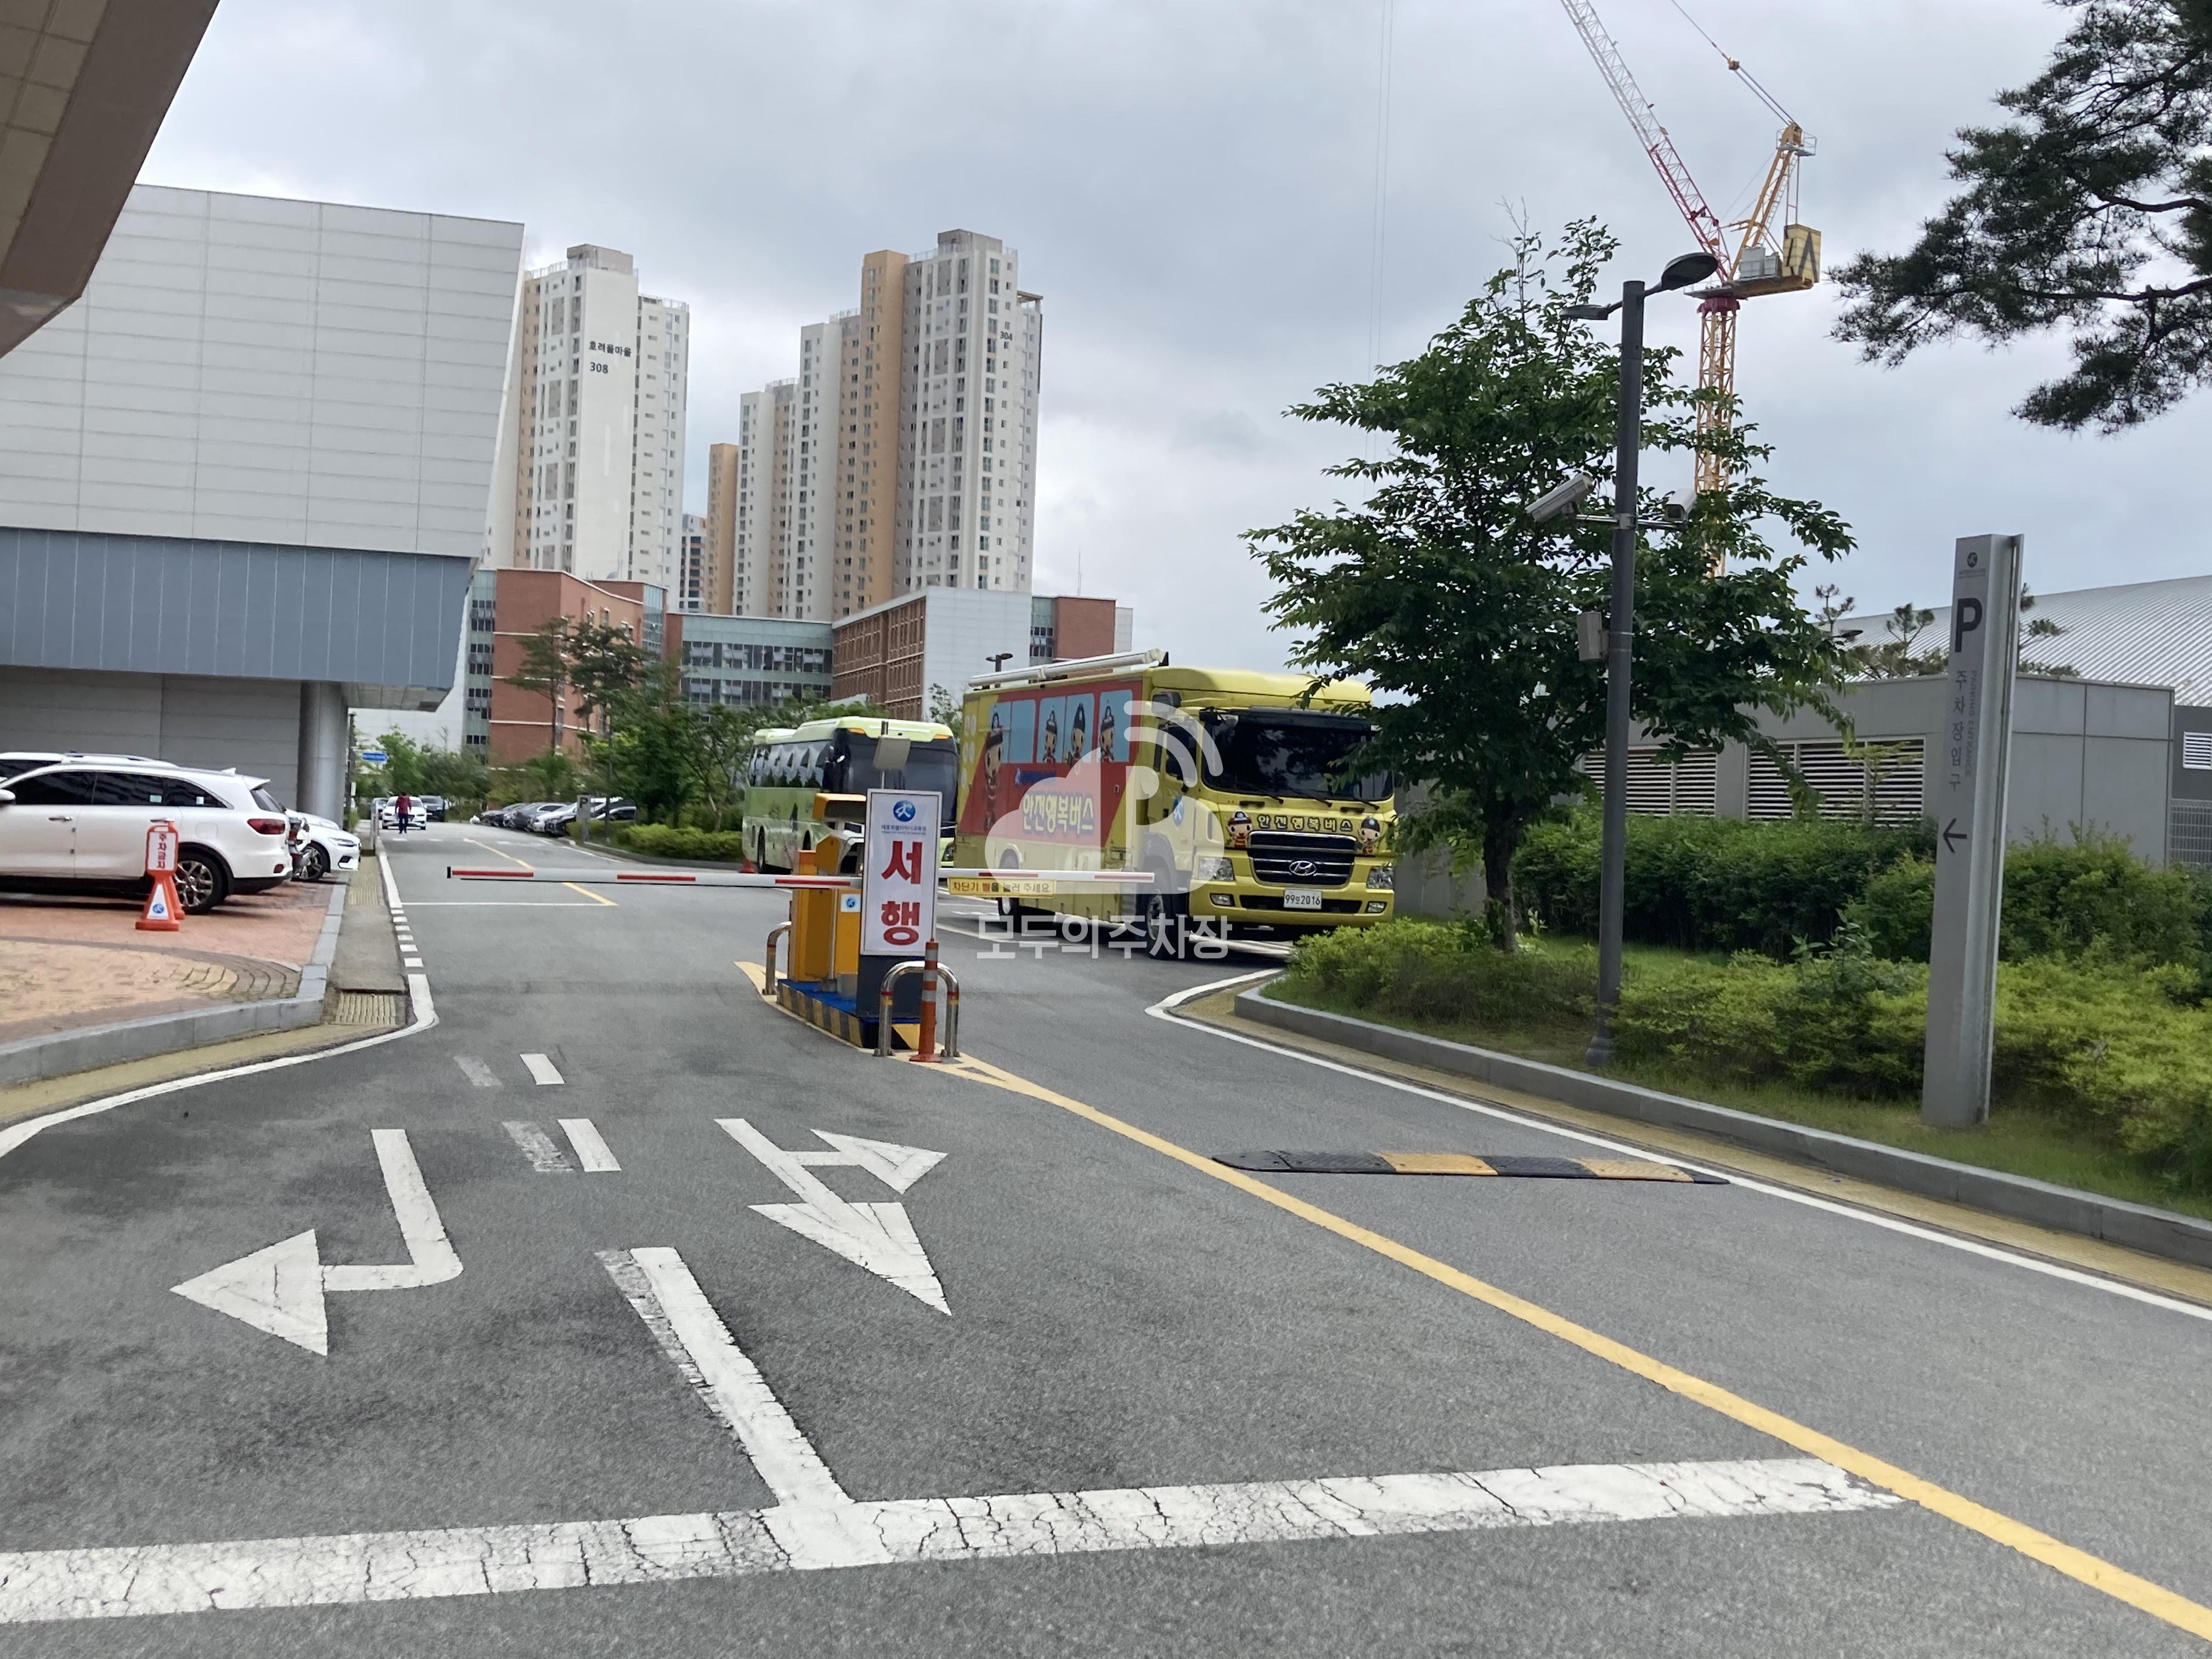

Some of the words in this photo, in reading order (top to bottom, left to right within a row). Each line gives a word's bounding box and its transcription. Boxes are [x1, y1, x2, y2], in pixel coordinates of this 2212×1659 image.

[1000, 331, 1012, 341] 304
[590, 362, 608, 374] 308
[1955, 597, 1982, 652] P
[579, 797, 588, 808] P
[1022, 793, 1094, 834] 안전행복버스
[1257, 814, 1353, 832] 안전행복버스
[881, 840, 923, 946] 서행
[952, 882, 979, 891] 차단기
